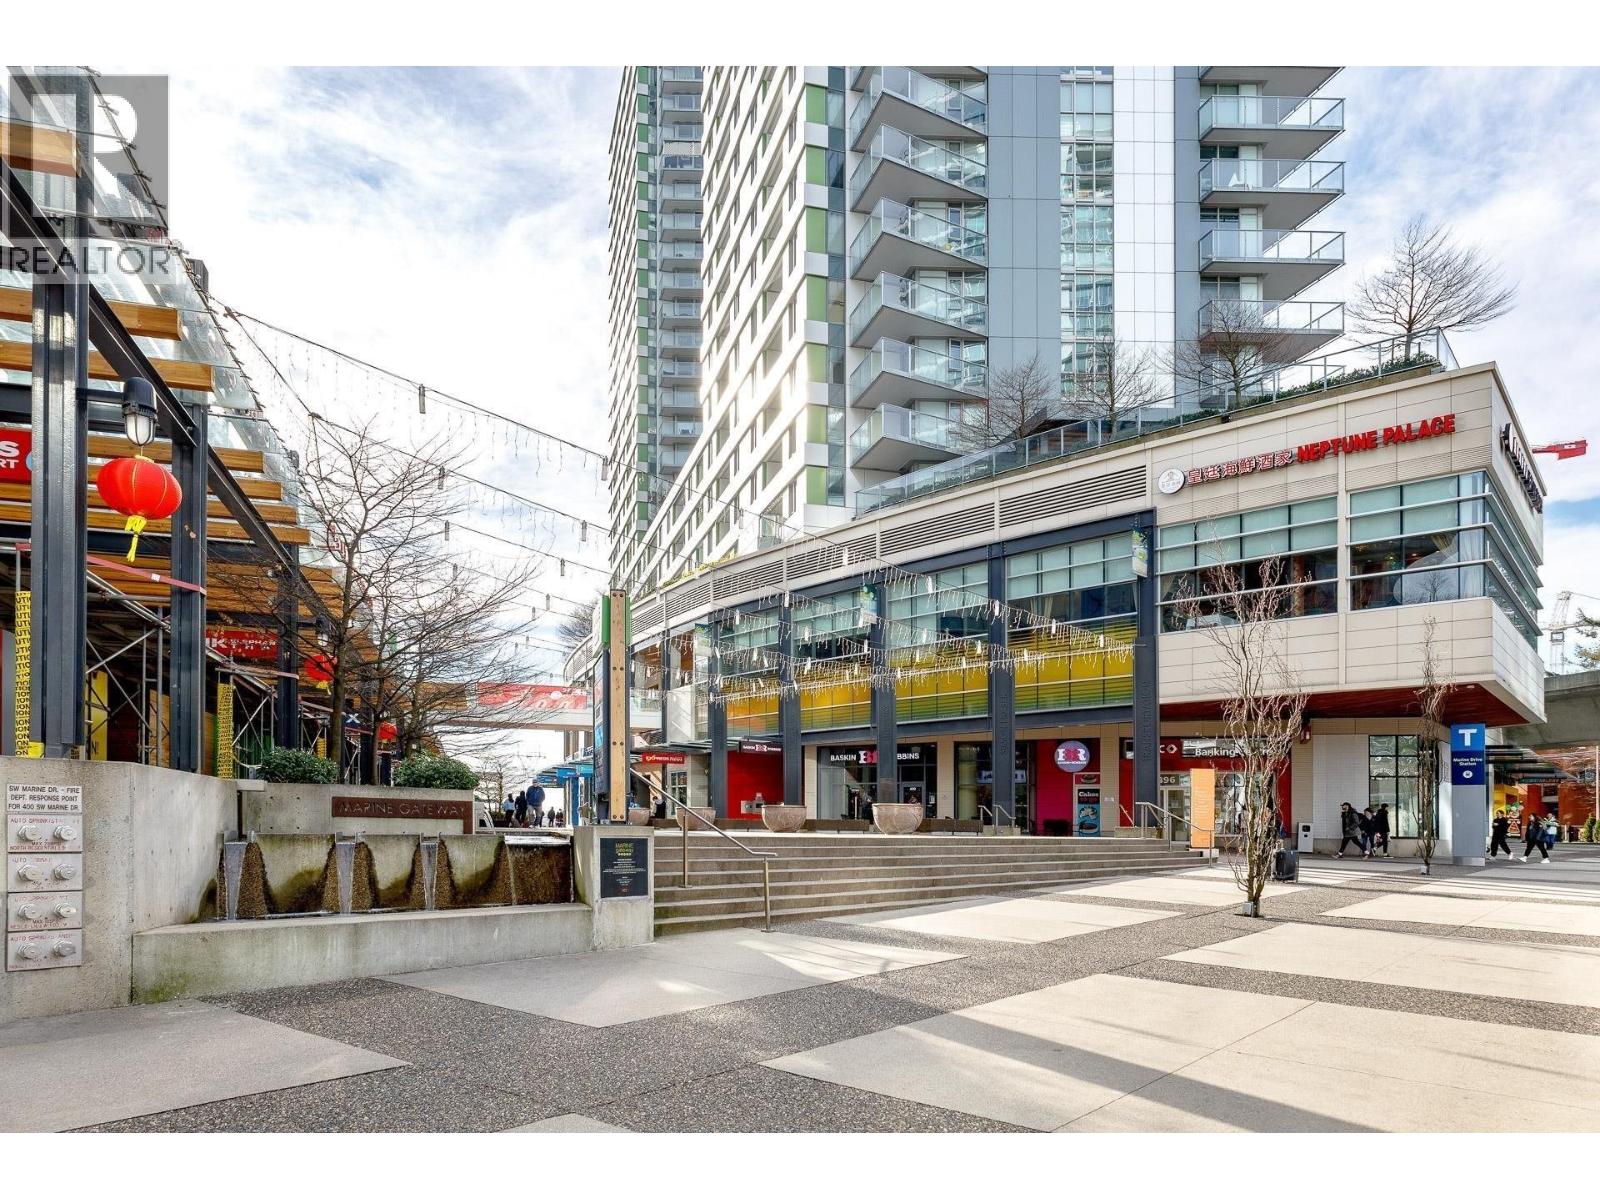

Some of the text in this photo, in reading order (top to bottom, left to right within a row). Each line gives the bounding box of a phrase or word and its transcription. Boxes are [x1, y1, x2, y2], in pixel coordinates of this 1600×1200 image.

[1297, 430, 1378, 463] NEPTUNE
[1382, 413, 1456, 446] PALACE
[1458, 729, 1477, 746] T
[897, 752, 920, 760] BBINS
[1195, 747, 1236, 758] Banking
[339, 801, 394, 814] MARINE
